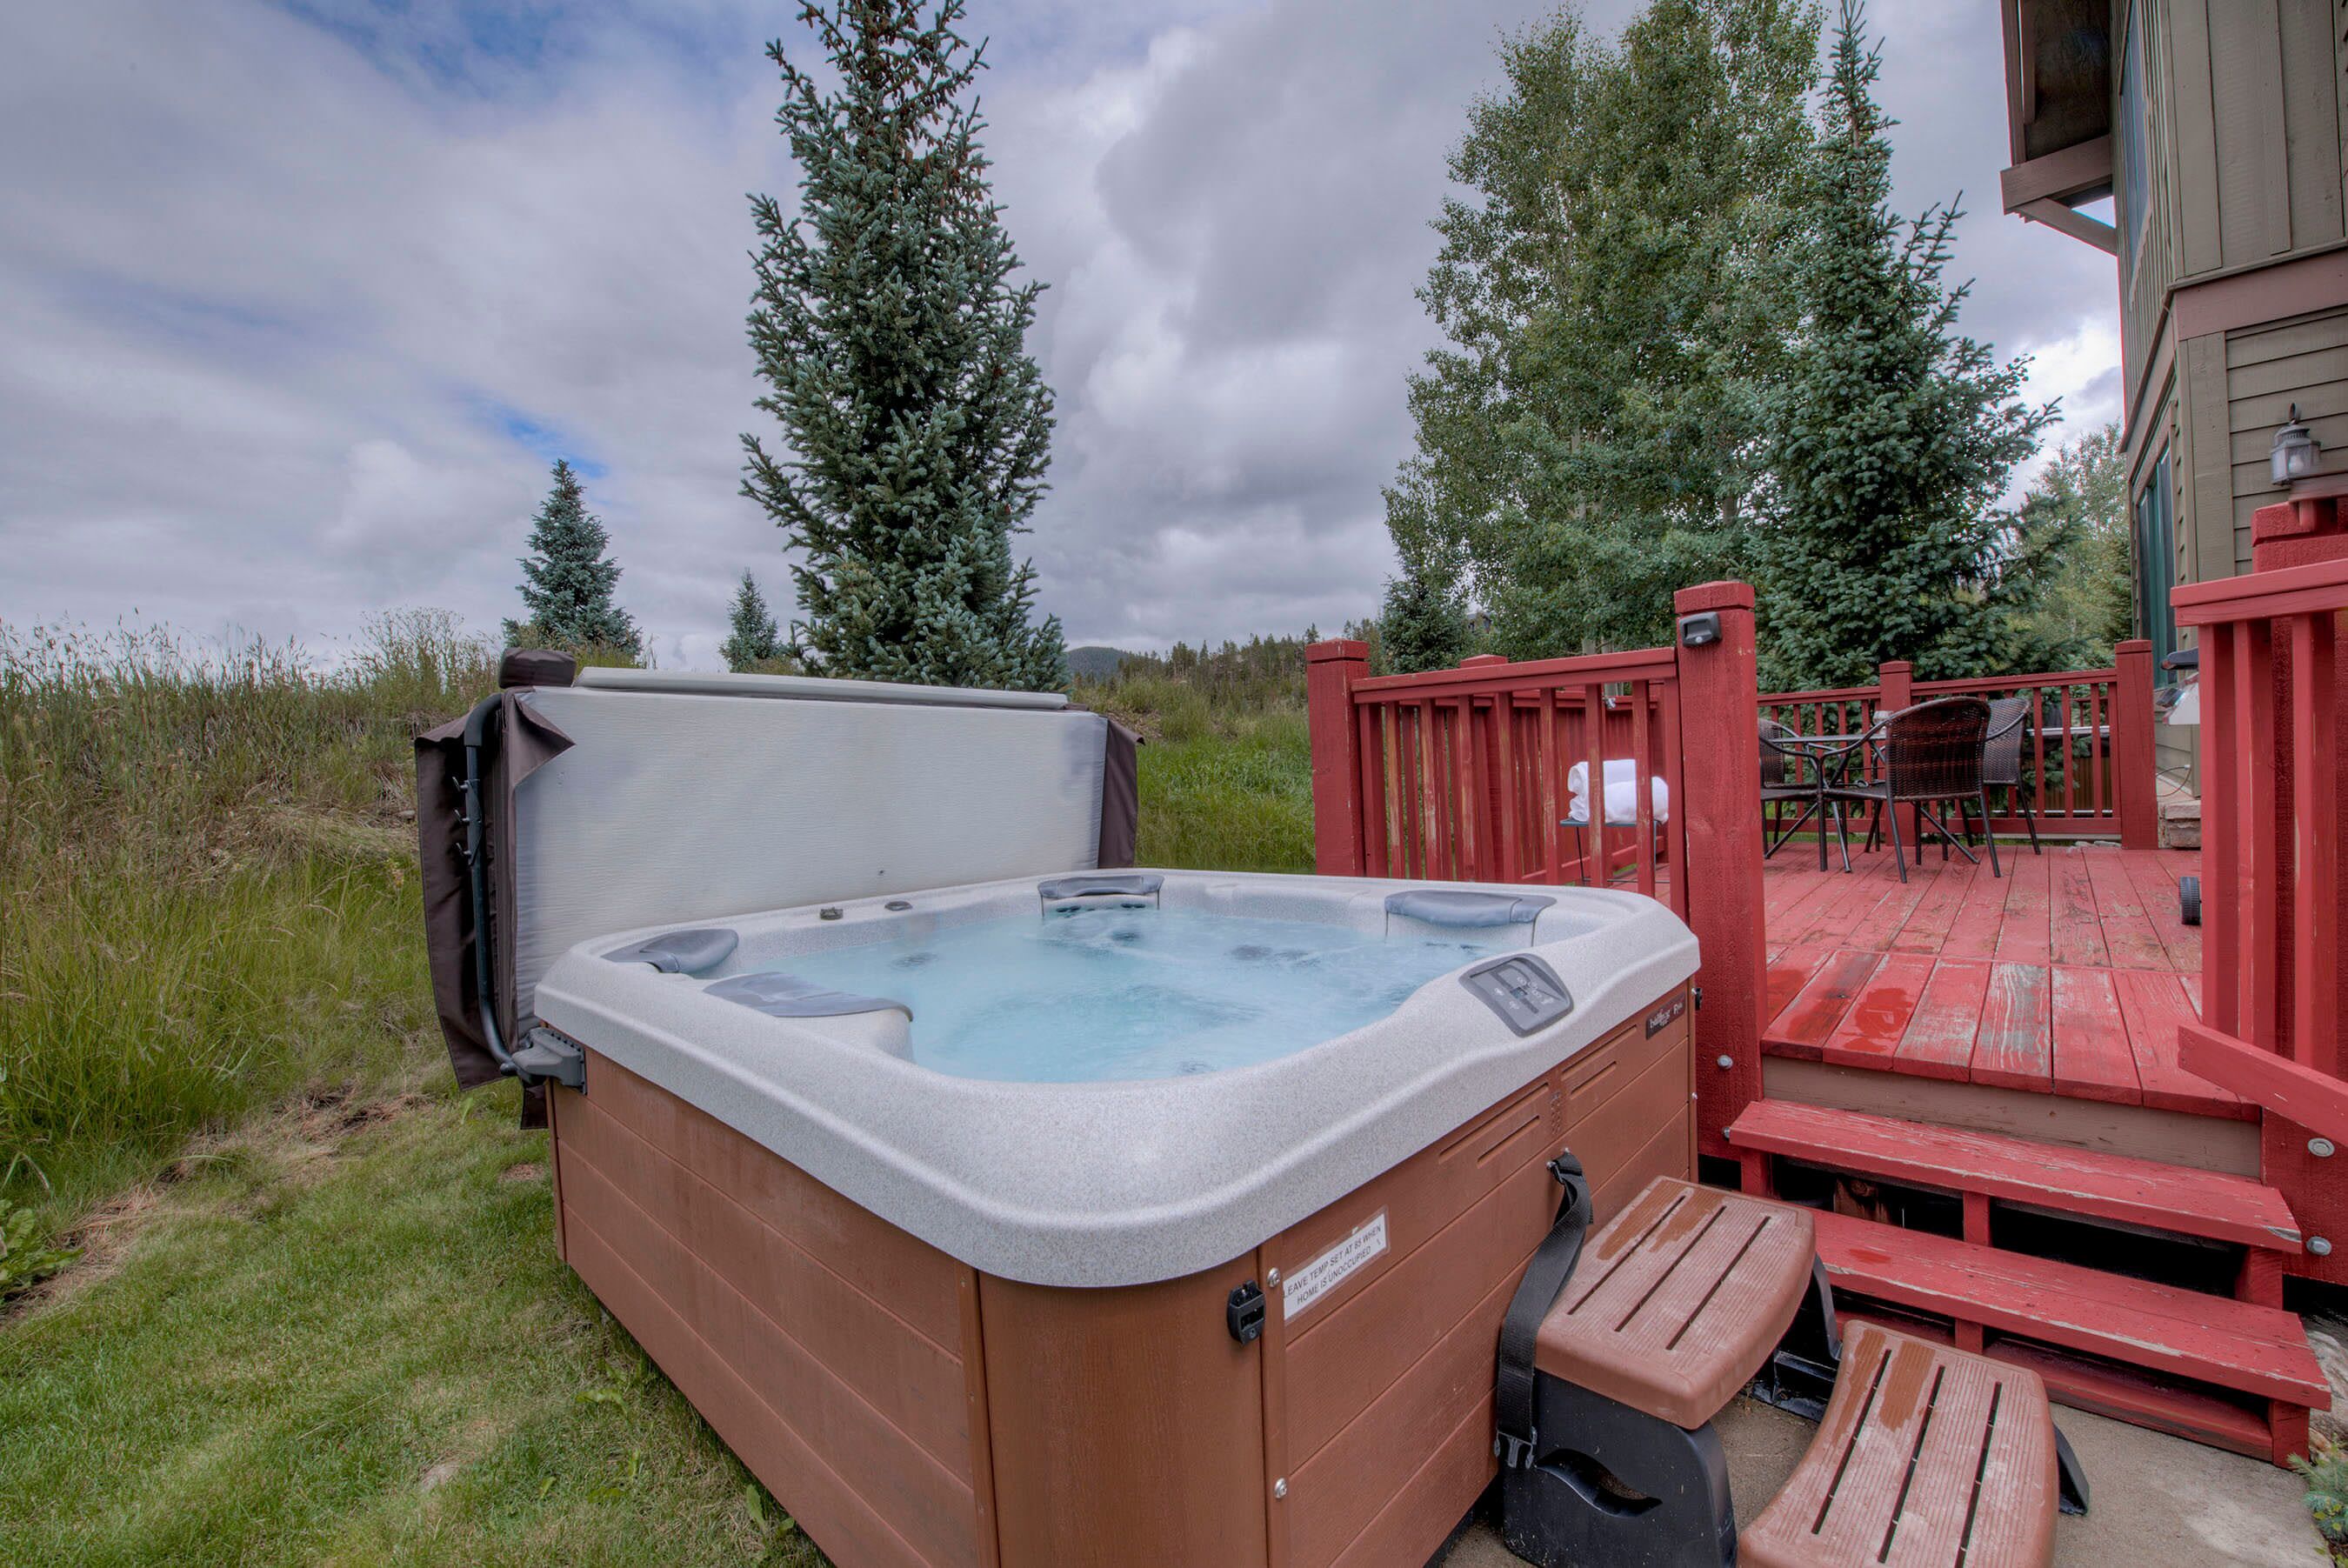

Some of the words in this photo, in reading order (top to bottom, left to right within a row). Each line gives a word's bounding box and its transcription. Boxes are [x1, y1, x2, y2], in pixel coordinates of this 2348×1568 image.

[1297, 1285, 1319, 1304] HOME
[1320, 1277, 1328, 1289] IS
[1328, 1245, 1371, 1282] UNOCCUPIED
[1310, 1261, 1329, 1280] TEMP
[1330, 1251, 1344, 1266] SET
[1344, 1244, 1353, 1258] AT
[1363, 1224, 1381, 1243] WHEN
